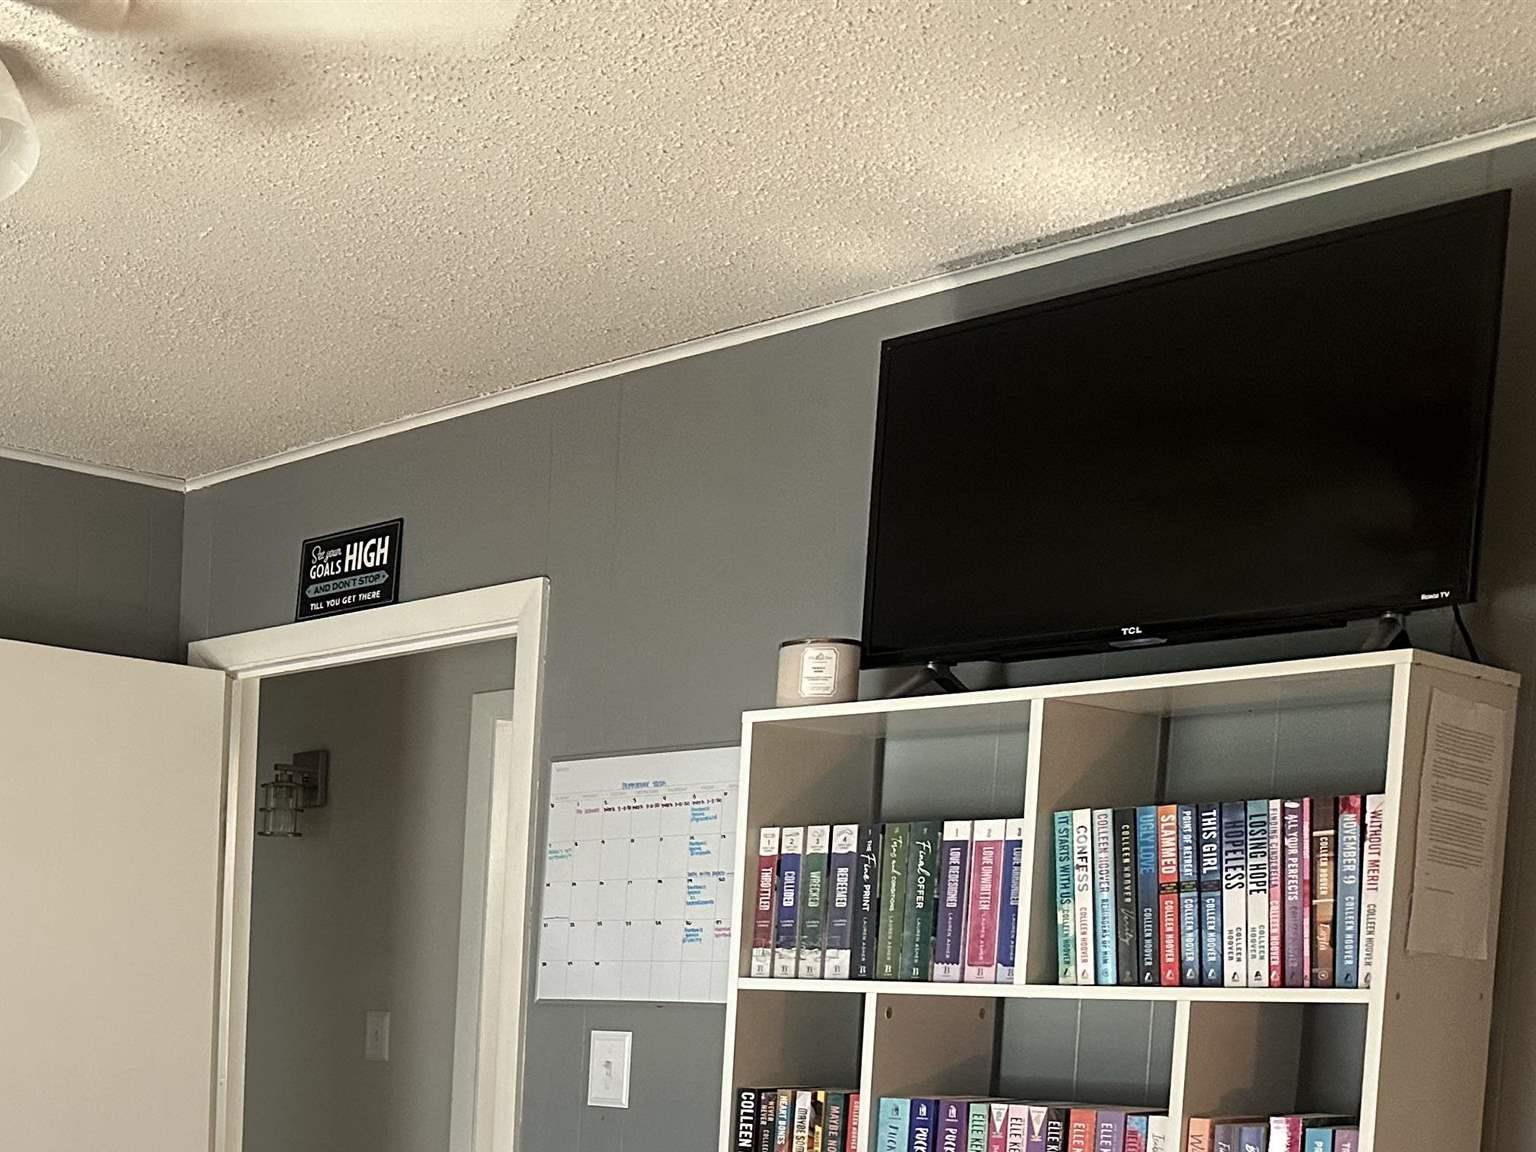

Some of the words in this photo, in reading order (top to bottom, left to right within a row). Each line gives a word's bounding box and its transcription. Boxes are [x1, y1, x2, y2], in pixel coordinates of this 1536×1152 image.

[344, 535, 390, 572] HIGH
[309, 560, 342, 579] GOALS
[314, 585, 330, 594] AND
[358, 574, 380, 585] STOP
[310, 602, 324, 611] TILL
[326, 598, 340, 608] YOU
[342, 595, 357, 604] GET
[358, 590, 381, 601] THERE
[1121, 626, 1143, 635] TCL
[1058, 816, 1069, 825] IT
[1140, 814, 1154, 845] UGLY
[1201, 810, 1217, 839] THIS
[1284, 814, 1297, 830] ALL
[1368, 810, 1383, 856] WITHOUT
[1058, 828, 1070, 862] STARTS
[1160, 815, 1176, 874] SLAMMED
[1249, 813, 1266, 859] LOSING
[1285, 832, 1297, 855] YOUR
[1342, 814, 1357, 871] NOVEMBER
[916, 840, 931, 877] Final
[1076, 826, 1088, 892] CONFESS
[1140, 848, 1155, 874] LOVE
[1202, 844, 1217, 874] GIRL
[1225, 820, 1244, 890] HOPELESS
[759, 867, 773, 910] THROTTLED
[1059, 865, 1071, 890] WITH
[1249, 864, 1267, 895] HOPE
[1288, 858, 1298, 901] PERFECTS
[1343, 876, 1356, 884] 9
[1366, 859, 1380, 892] MERIT
[916, 876, 925, 909] OFFER
[1060, 892, 1071, 904] US
[739, 1092, 755, 1147] COLLEEN
[779, 1096, 787, 1118] HEART
[796, 1108, 808, 1133] MAYBE
[777, 1121, 786, 1144] BONES
[828, 1106, 839, 1136] MAYBE
[972, 1113, 984, 1134] ELLE
[1010, 1118, 1023, 1138] ELLE
[1047, 1121, 1061, 1141] ELLE
[1072, 1123, 1085, 1145] ELLE
[1100, 1123, 1112, 1146] ELLE
